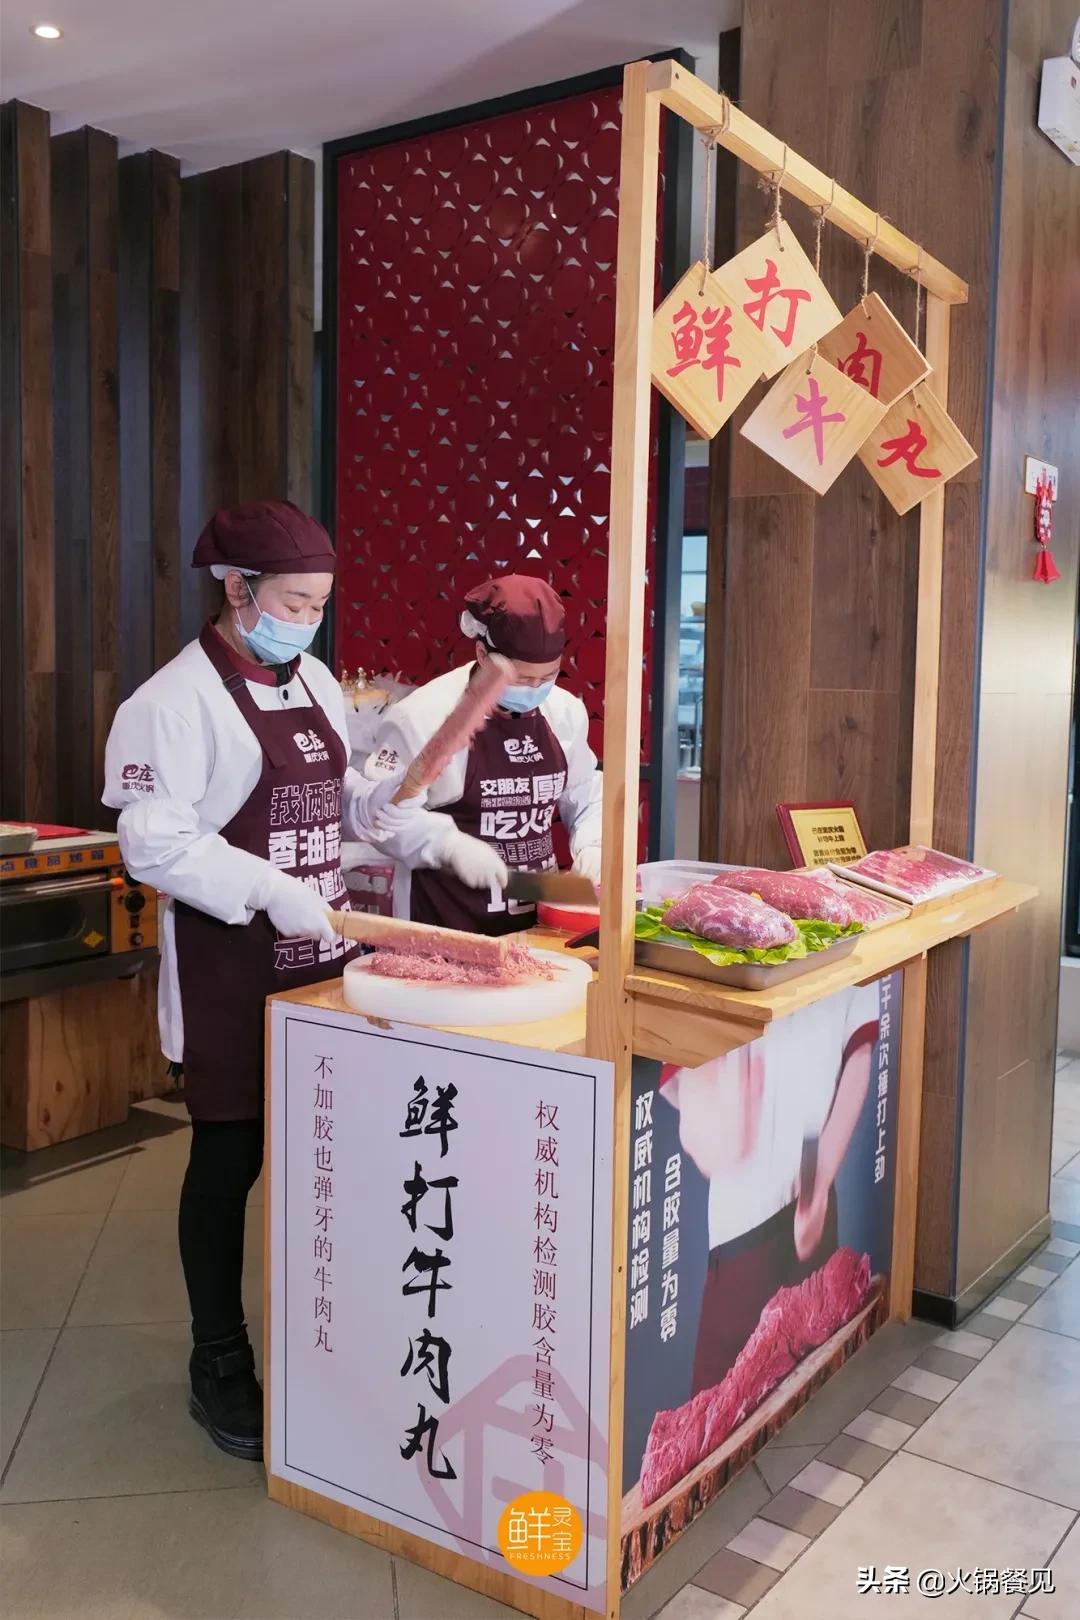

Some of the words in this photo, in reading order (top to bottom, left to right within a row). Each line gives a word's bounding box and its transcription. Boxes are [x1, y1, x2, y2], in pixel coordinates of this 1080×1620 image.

[742, 258, 811, 348] 打
[666, 301, 741, 402] 鲜
[837, 332, 883, 399] 肉
[782, 378, 846, 465] 牛
[877, 419, 942, 478] 丸
[122, 764, 155, 781] 巴庄
[293, 729, 325, 753] 巴庄
[504, 735, 539, 755] 巴庄
[480, 777, 530, 796] 交朋友
[313, 1053, 334, 1353] 不加胶也弹牙的牛肉丸
[629, 1089, 655, 1330] 权威机构检测
[399, 1075, 459, 1480] 鲜打牛肉丸
[531, 1099, 560, 1465] 权威机构检测胶含量为零
[660, 1153, 682, 1343] 含胶量为零
